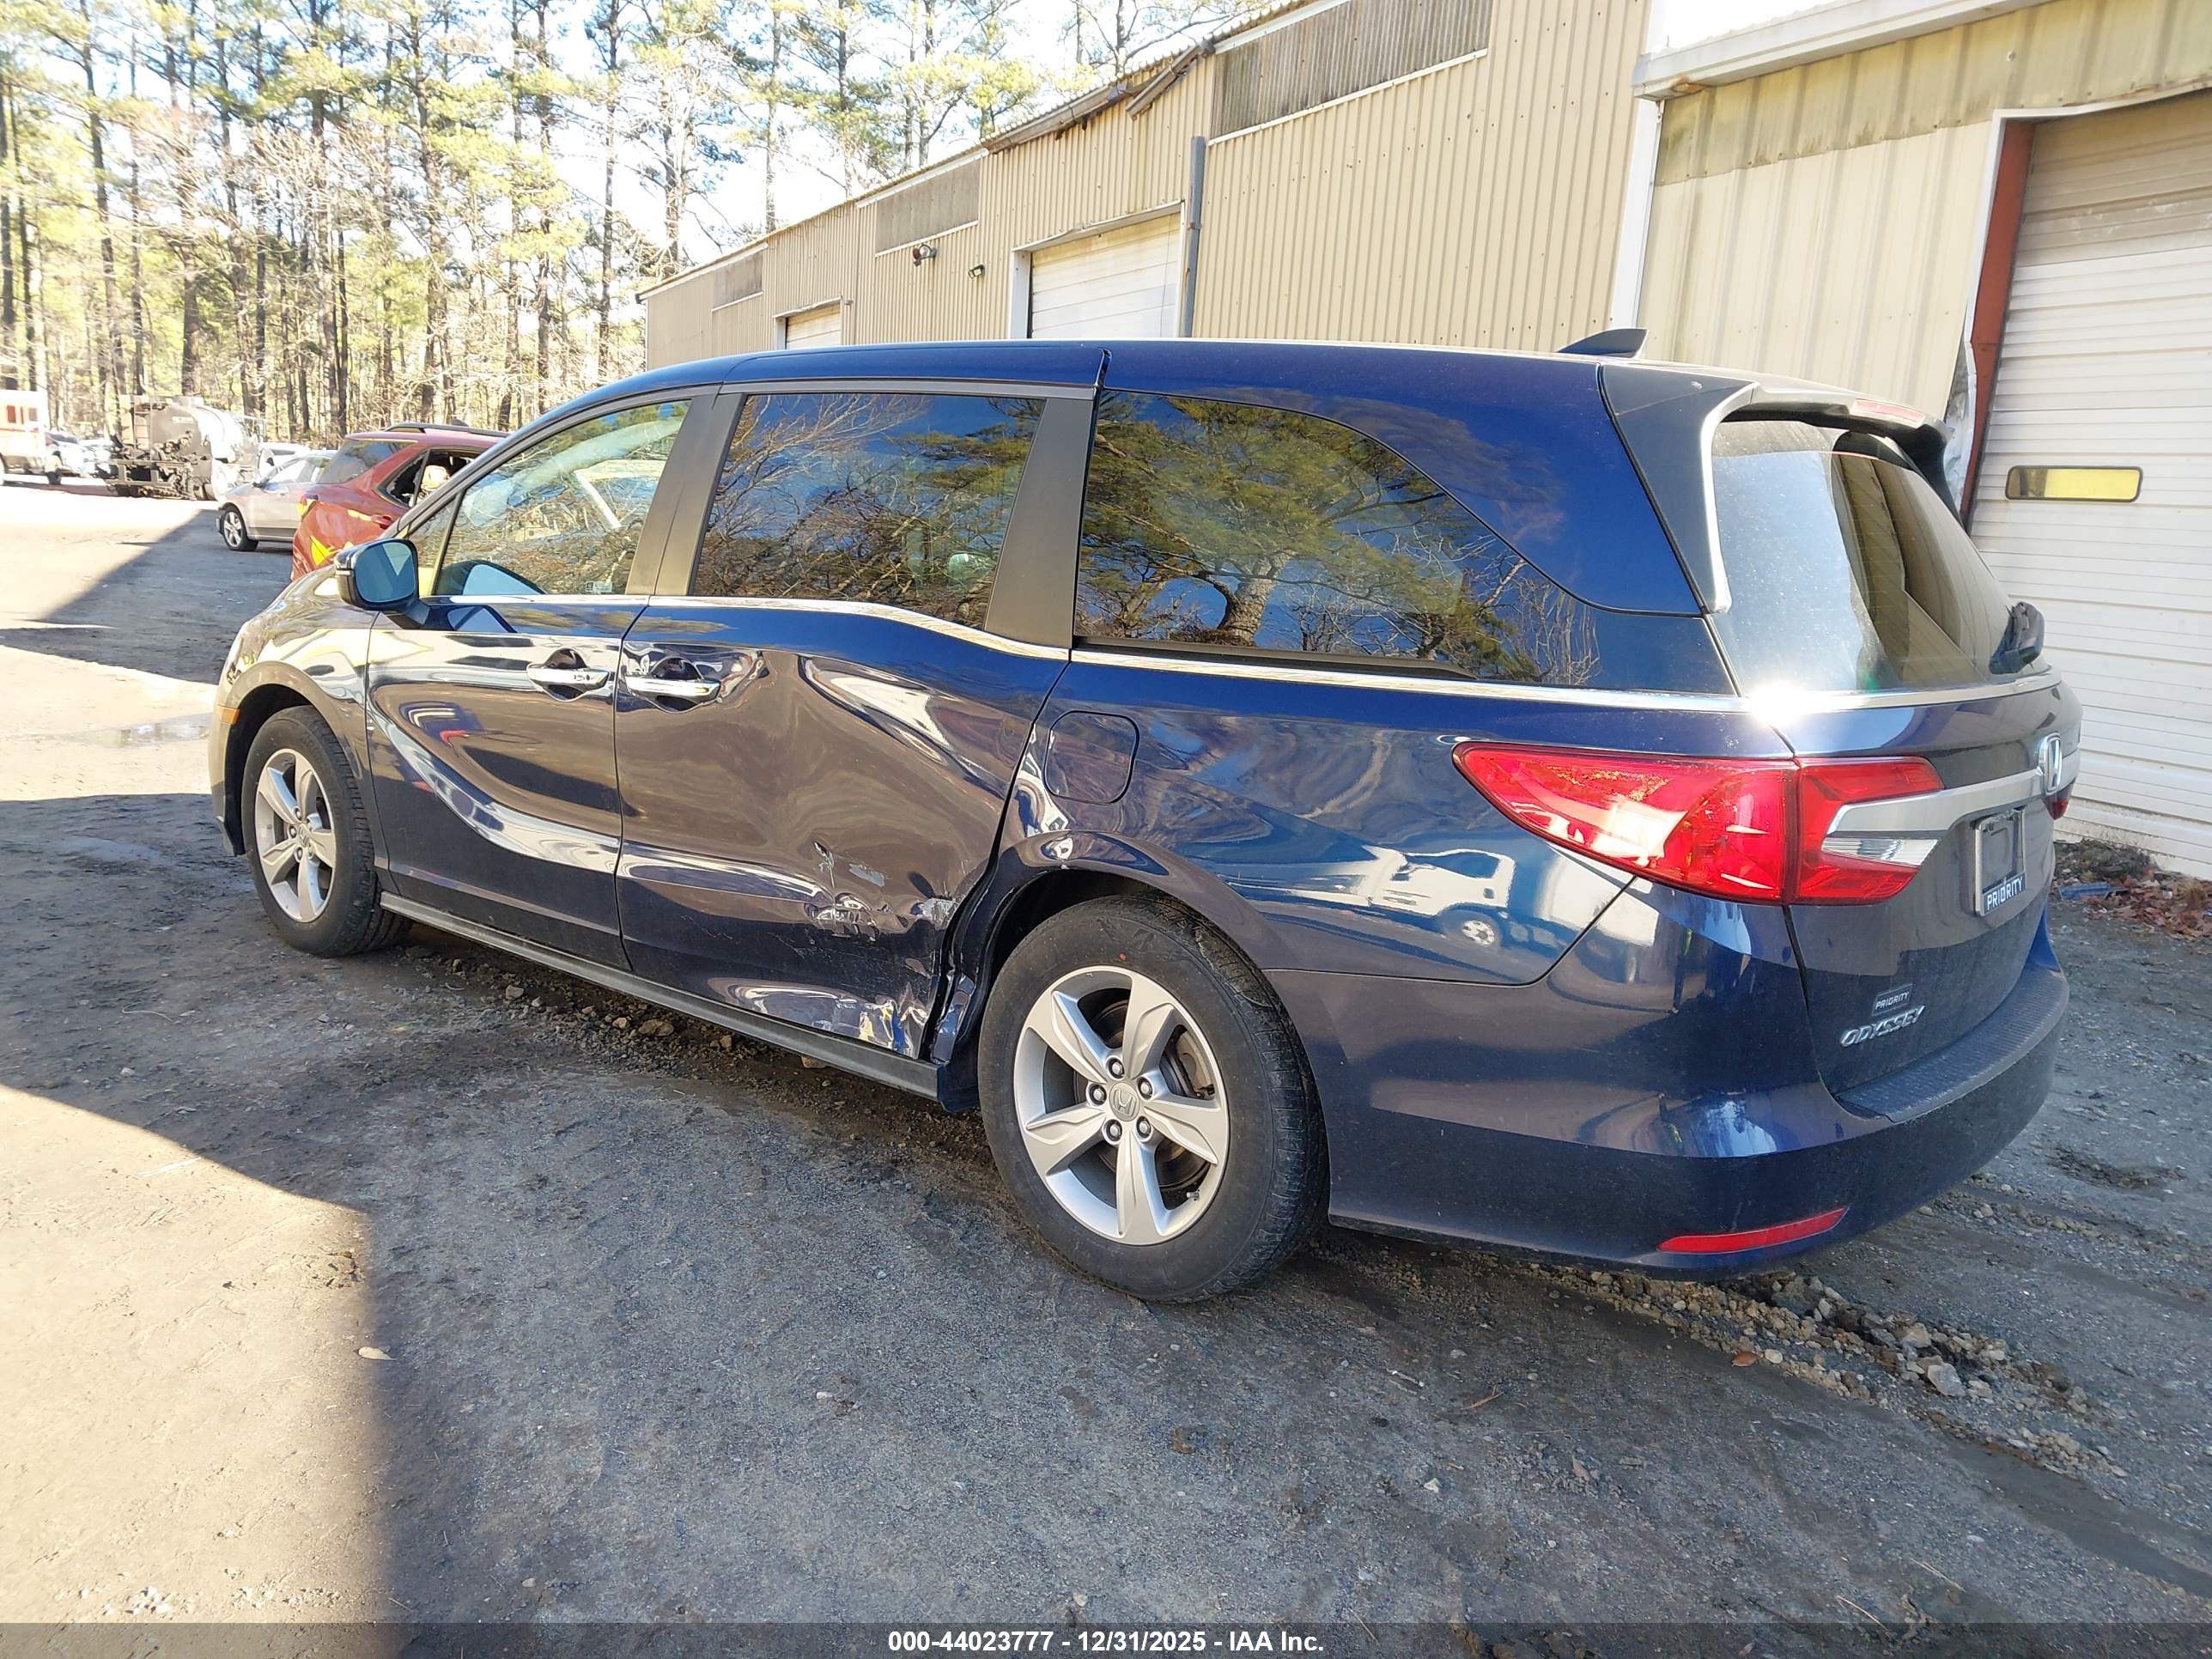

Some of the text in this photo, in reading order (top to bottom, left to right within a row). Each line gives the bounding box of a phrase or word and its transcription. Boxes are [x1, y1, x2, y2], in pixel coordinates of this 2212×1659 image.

[1986, 876, 2023, 911] PRIORITY
[1875, 991, 1910, 1011] PRIORITY
[1839, 1005, 1926, 1048] ODYSSEY
